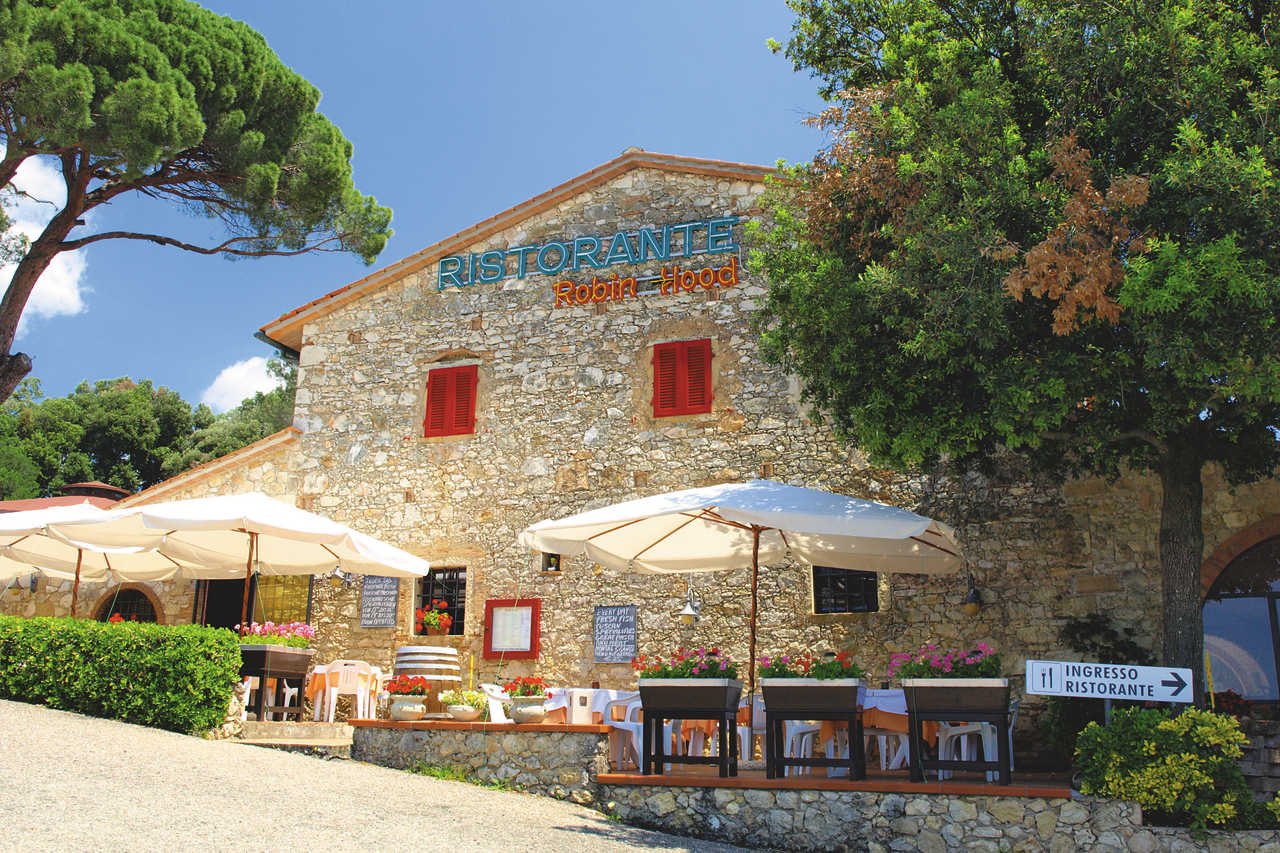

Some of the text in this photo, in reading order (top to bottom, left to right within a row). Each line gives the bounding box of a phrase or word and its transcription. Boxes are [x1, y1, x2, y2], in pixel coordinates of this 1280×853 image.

[437, 216, 739, 291] RISTORANTE
[552, 256, 739, 308] Robin Hood
[1065, 664, 1138, 680] INGRESSO
[1065, 681, 1154, 697] RISTORANTE
